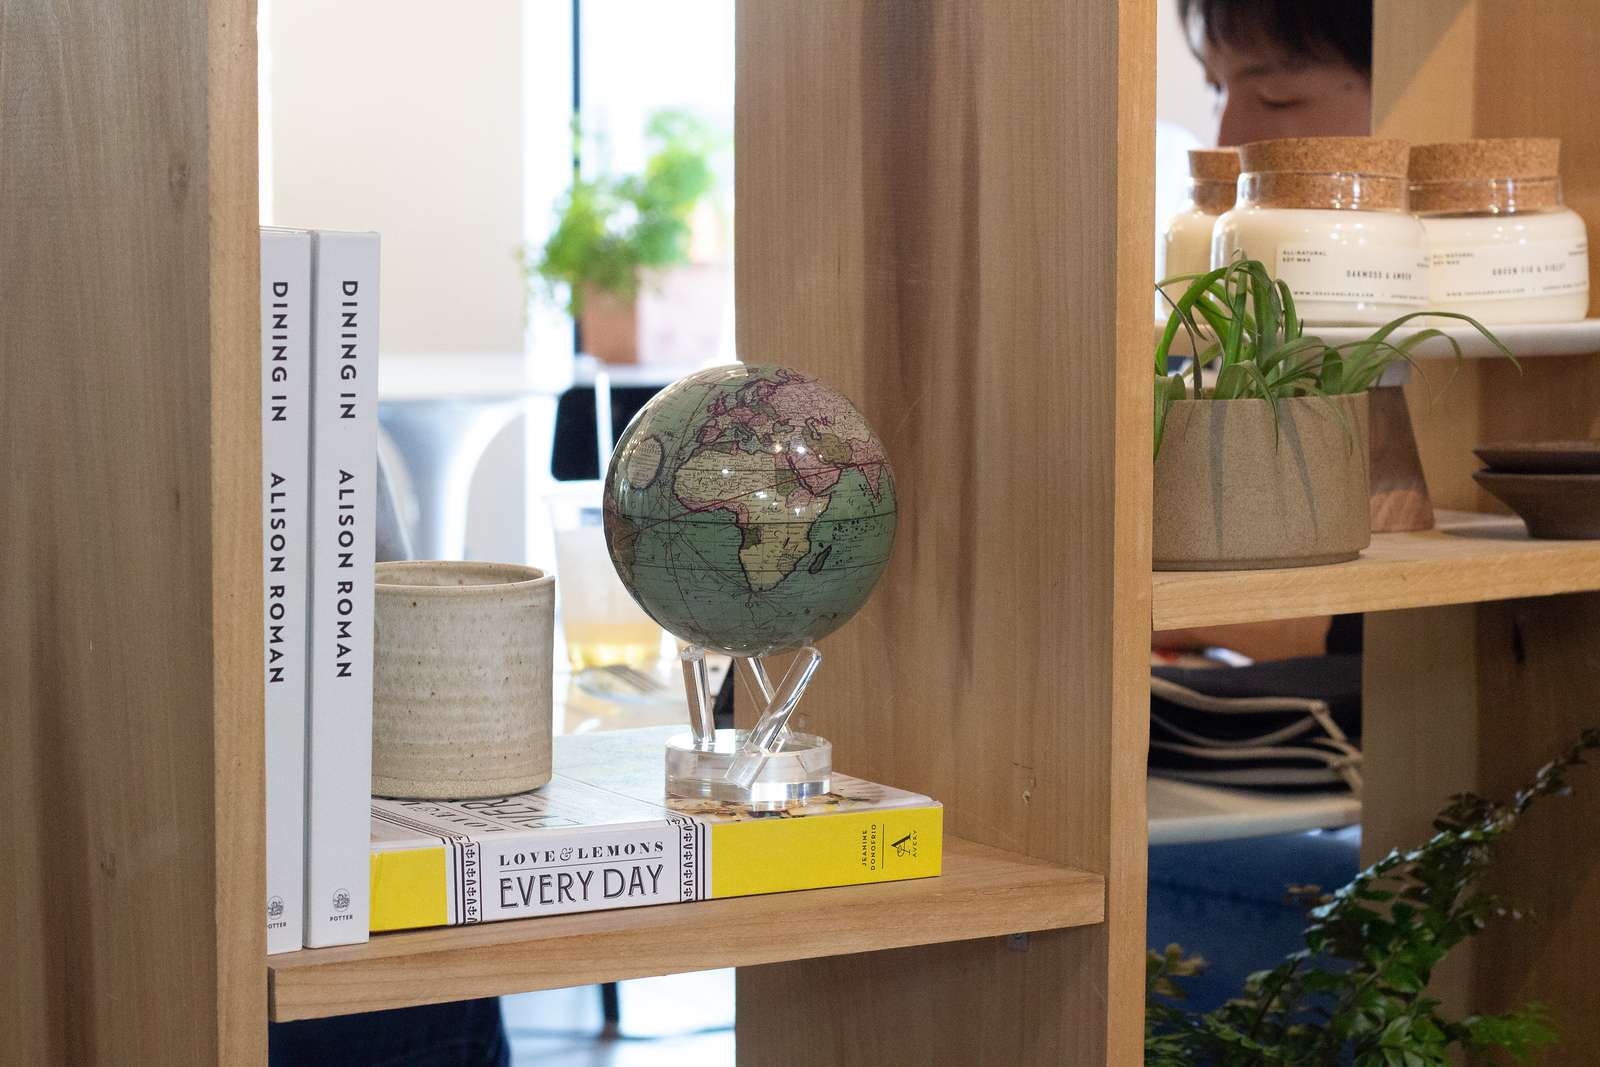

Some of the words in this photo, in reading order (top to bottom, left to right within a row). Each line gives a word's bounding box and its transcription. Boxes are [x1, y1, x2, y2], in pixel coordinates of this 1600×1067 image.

[272, 282, 288, 382] DINING
[340, 281, 358, 380] DINING
[271, 395, 287, 421] IN
[340, 393, 356, 419] IN
[270, 472, 286, 572] ALISON
[338, 469, 355, 568] ALISON
[269, 585, 285, 683] ROMAN
[336, 581, 353, 678] ROMAN
[268, 921, 287, 929] OTTER
[499, 870, 595, 908] EVERY
[603, 864, 664, 899] DAY
